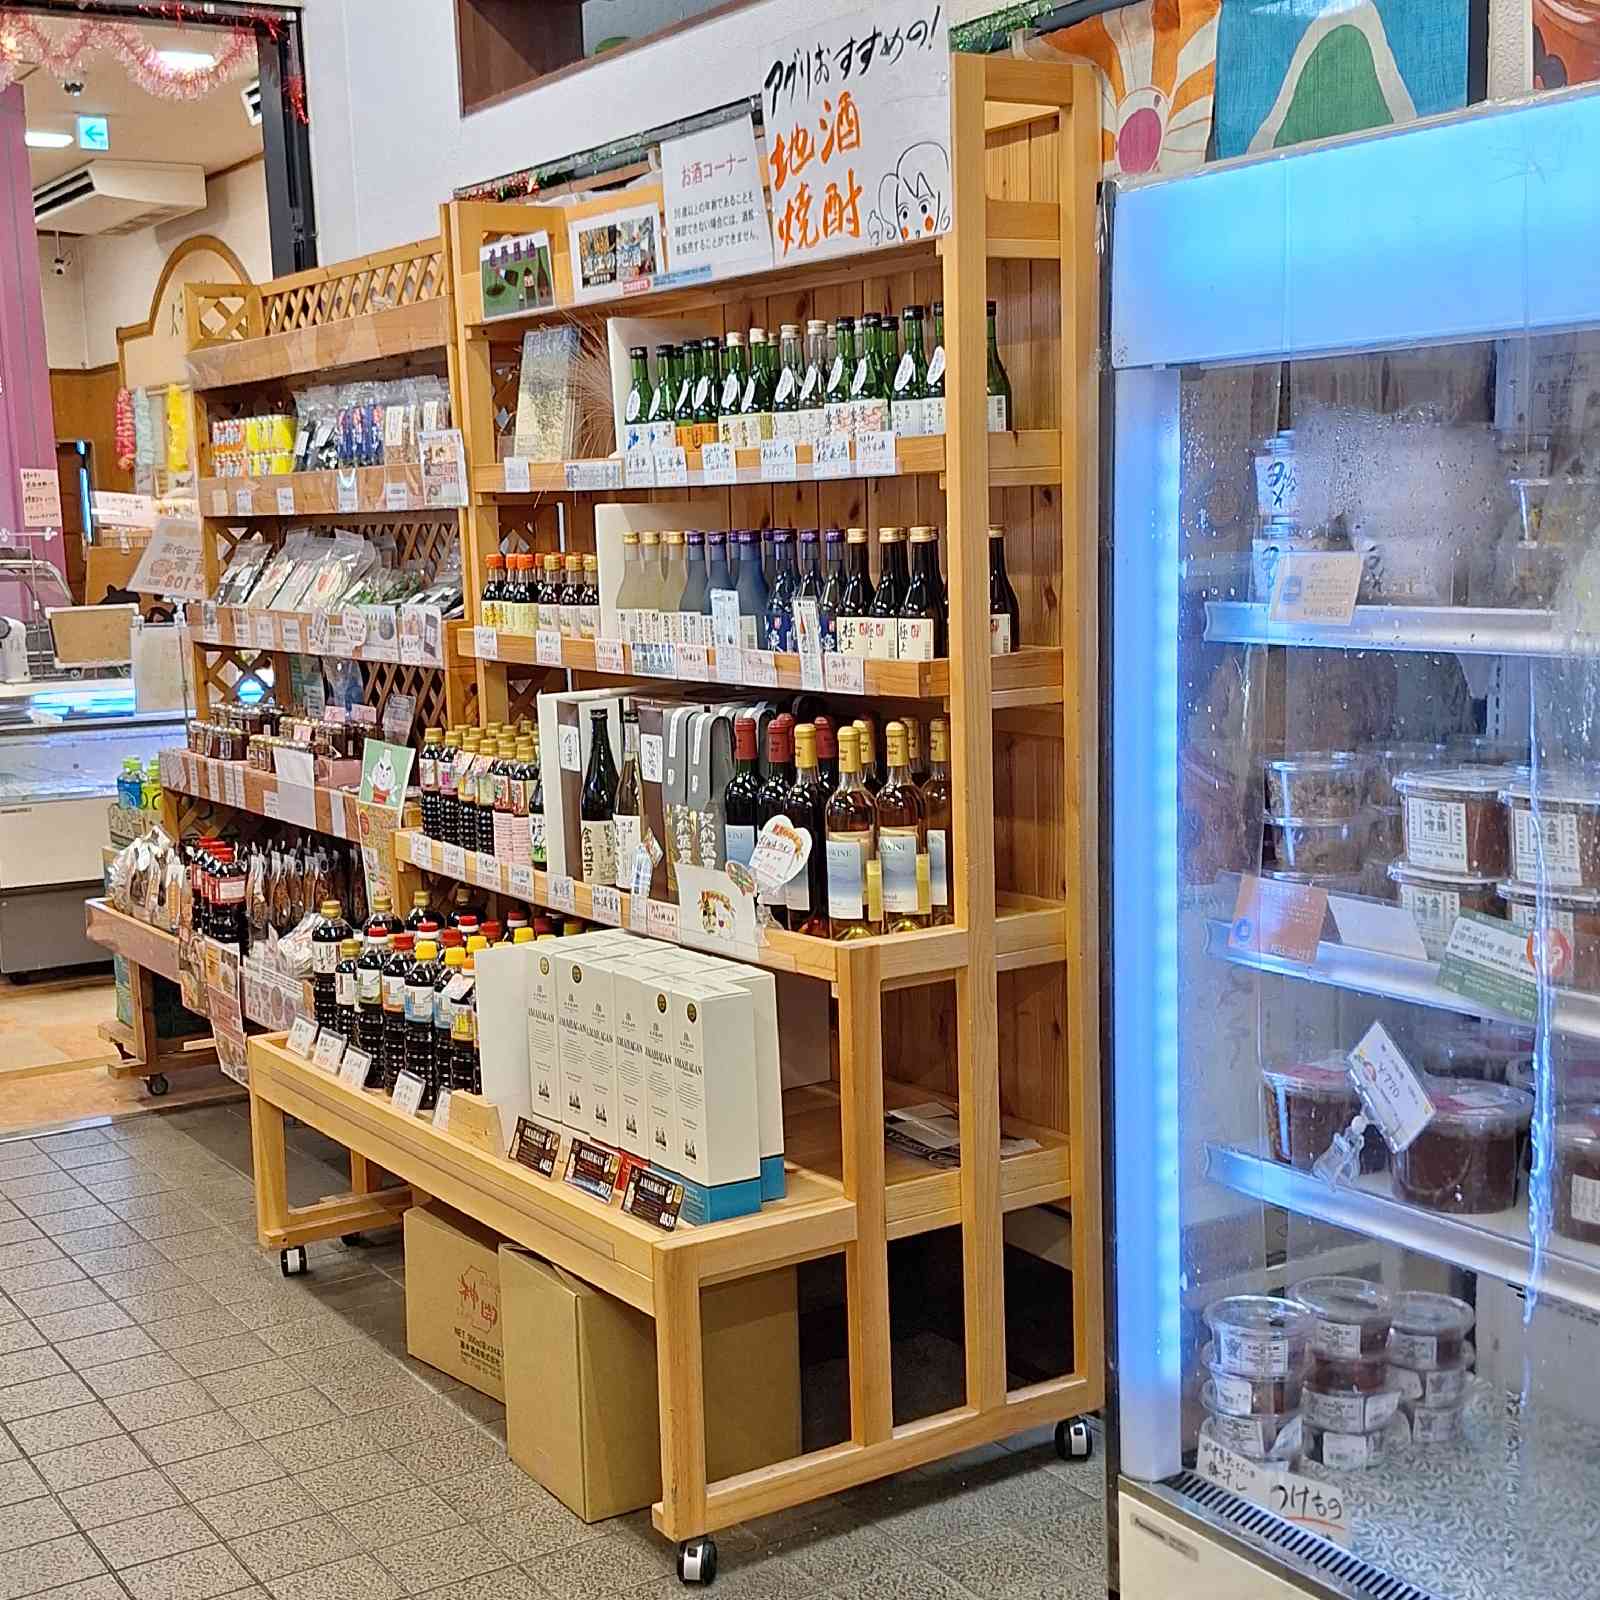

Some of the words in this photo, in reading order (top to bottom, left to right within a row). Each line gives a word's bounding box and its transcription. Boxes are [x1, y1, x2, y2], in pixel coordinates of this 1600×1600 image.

[681, 152, 748, 188] お酒コーナー
[769, 91, 861, 191] 地酒
[778, 168, 862, 256] 焼酎
[1271, 1484, 1342, 1521] つけもの
